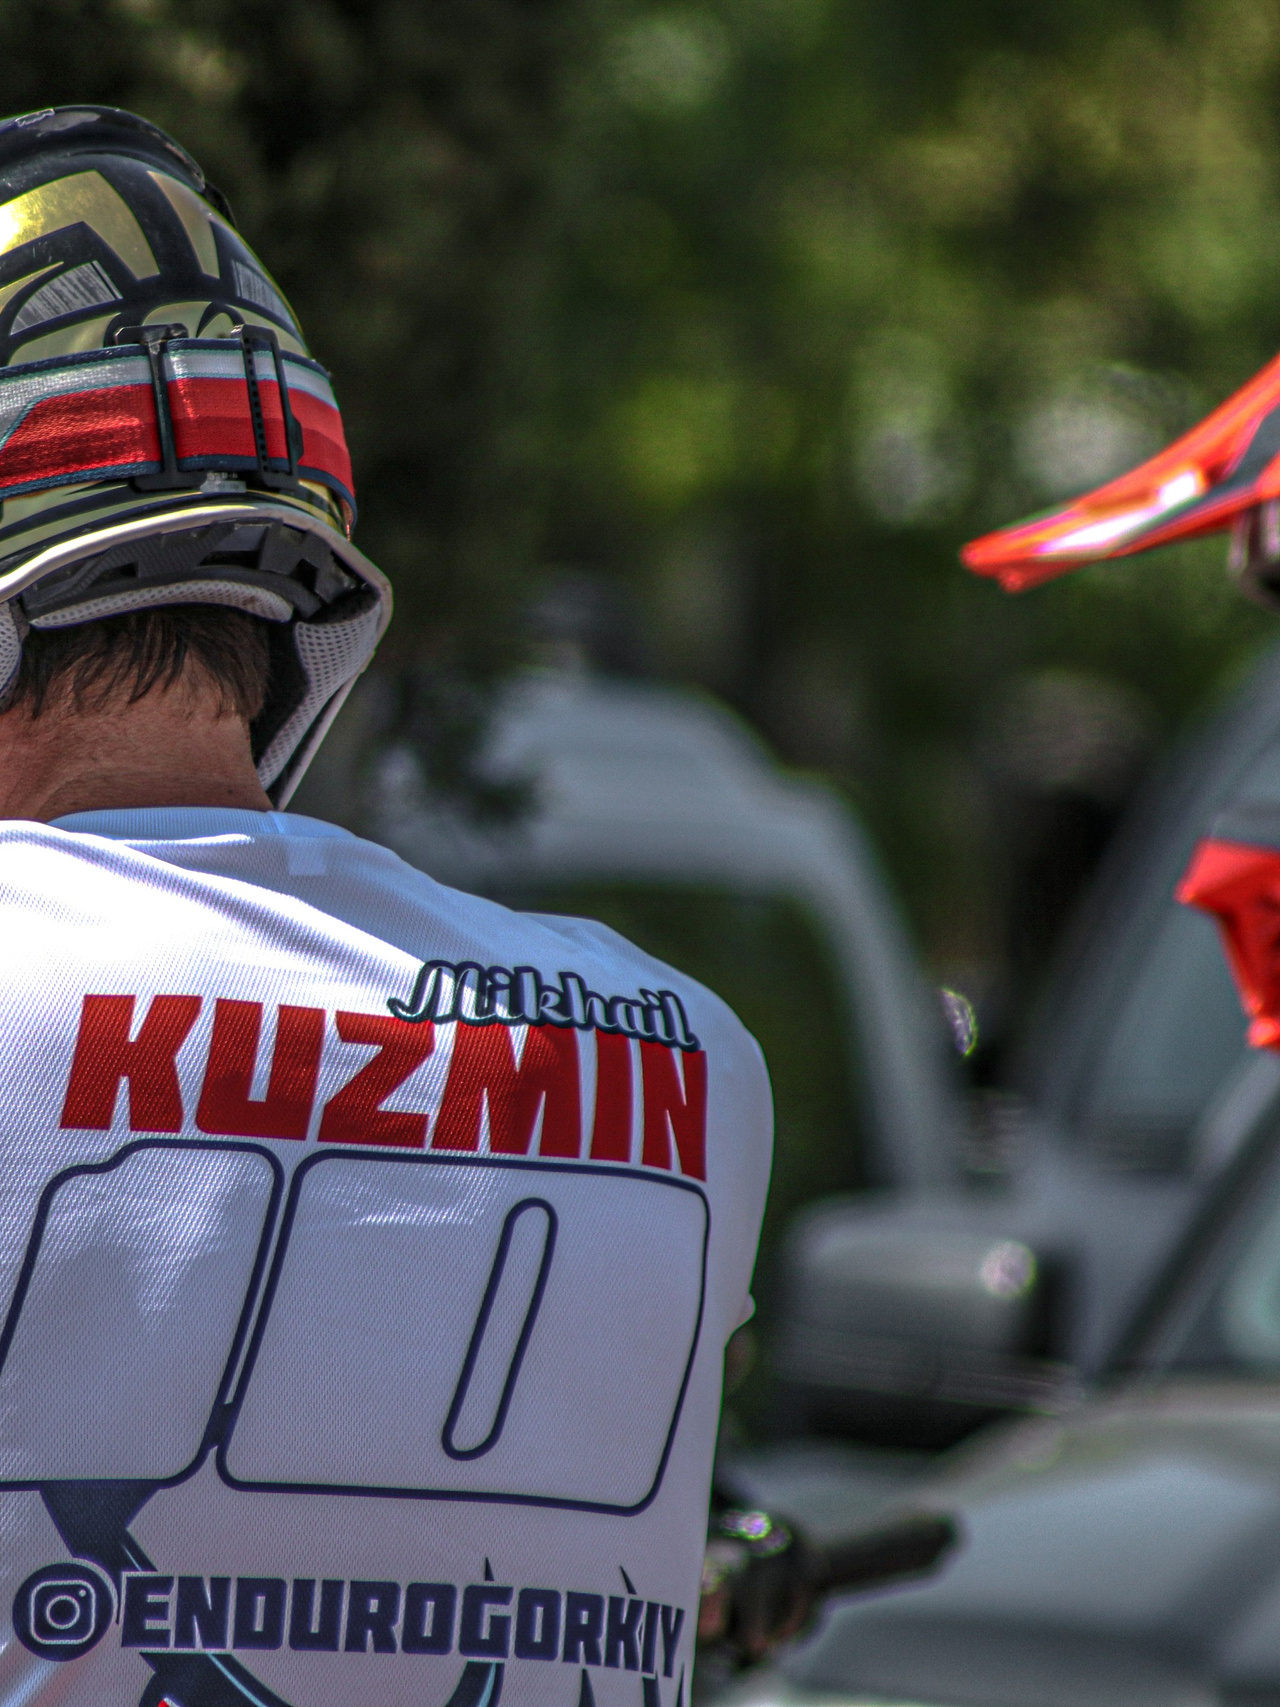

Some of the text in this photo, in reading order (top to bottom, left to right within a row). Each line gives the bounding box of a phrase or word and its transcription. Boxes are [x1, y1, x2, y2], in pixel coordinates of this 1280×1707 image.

[387, 958, 701, 1053] Mikhail
[59, 992, 708, 1183] KUZMIN
[120, 1574, 687, 1679] ENDUROGORKIY
